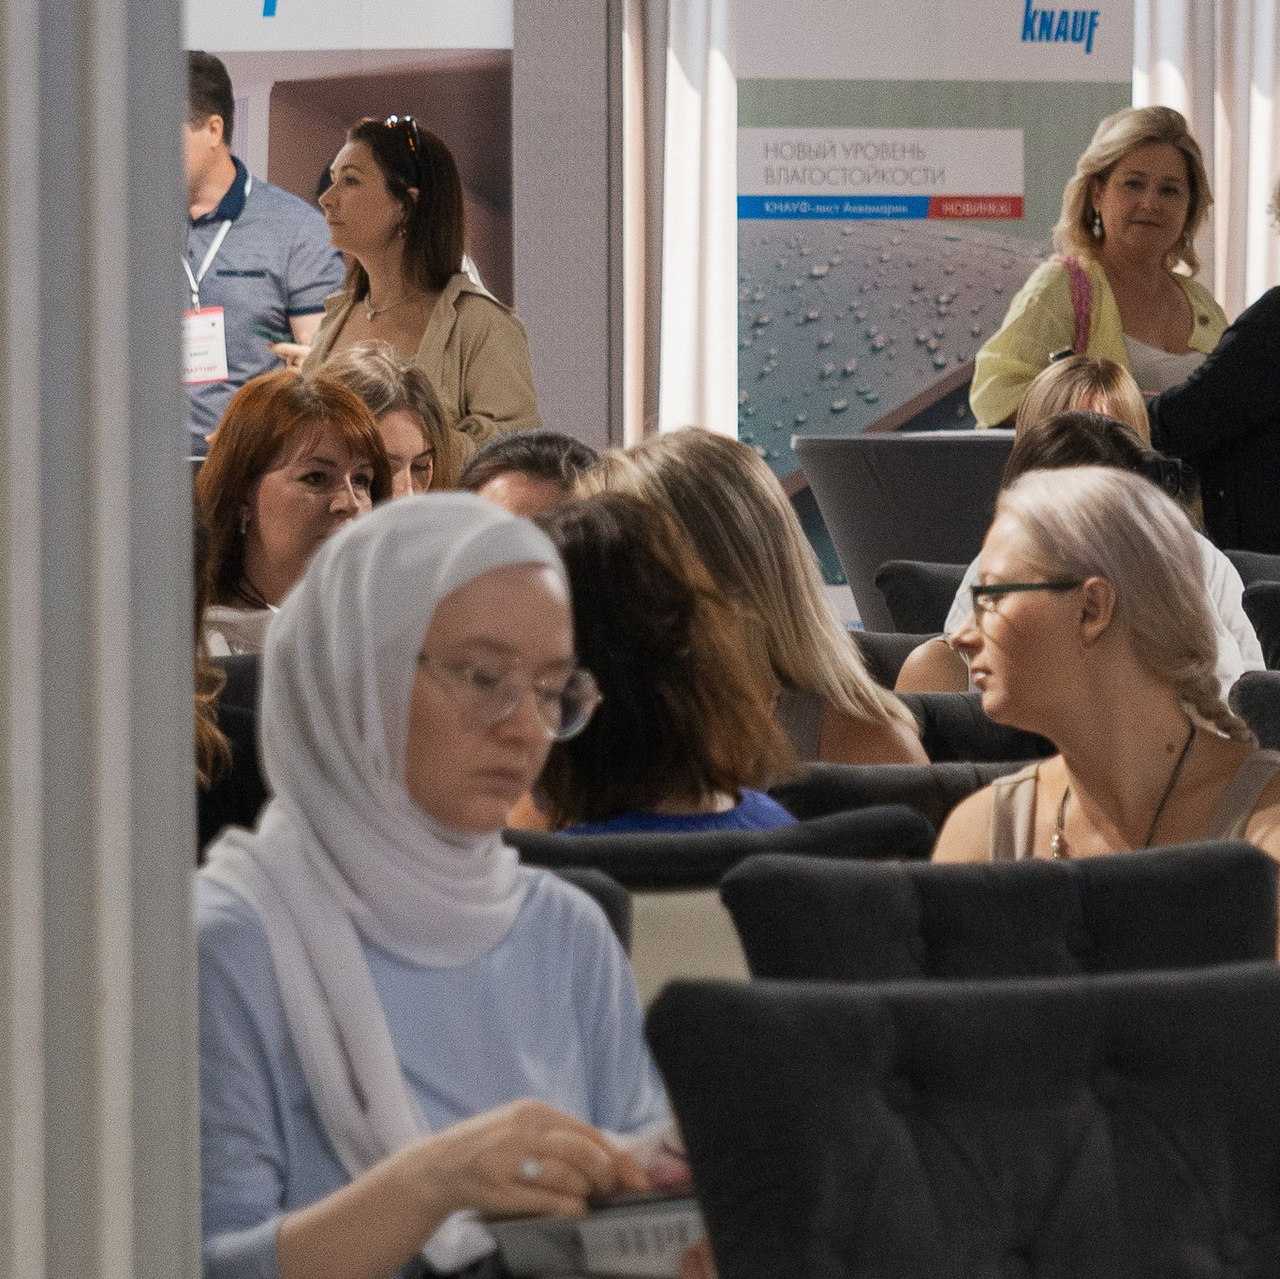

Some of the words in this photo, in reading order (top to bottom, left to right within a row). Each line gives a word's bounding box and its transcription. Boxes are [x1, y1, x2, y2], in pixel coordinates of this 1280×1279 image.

[763, 137, 837, 162] НОВЫЙ
[843, 140, 927, 162] УРОВЕНЬ
[763, 163, 947, 187] ВЛАГОСТОЙКОСТИ
